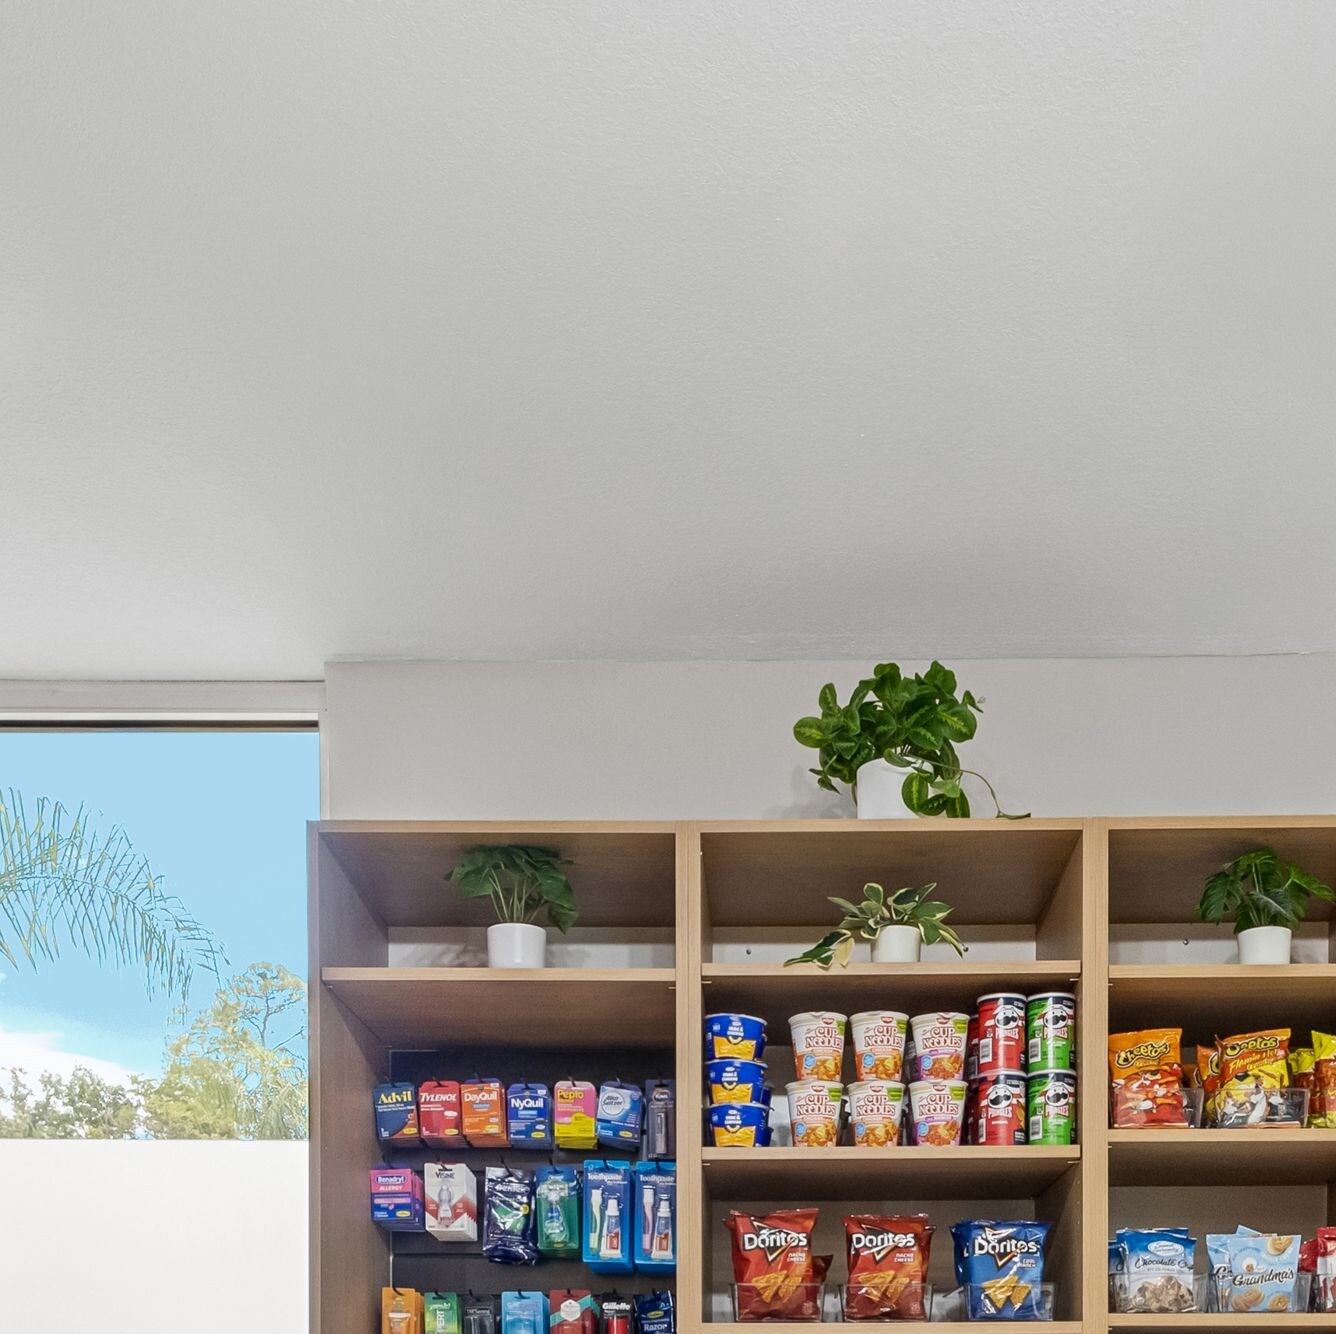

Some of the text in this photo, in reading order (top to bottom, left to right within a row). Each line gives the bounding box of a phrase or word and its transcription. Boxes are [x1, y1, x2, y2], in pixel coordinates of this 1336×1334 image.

[815, 1027, 839, 1037] CUP
[874, 1026, 898, 1036] CUP
[930, 1027, 955, 1037] CUP
[922, 1037, 962, 1049] NOODLES
[1226, 1037, 1278, 1056] Ceetos
[1117, 1043, 1168, 1064] Cheetos
[378, 1091, 412, 1104] Advil
[420, 1092, 457, 1102] TYLENOL
[464, 1092, 497, 1103] DayQuil
[557, 1089, 584, 1100] Pepto
[804, 1095, 830, 1105] CUP
[864, 1095, 889, 1105] CUP
[927, 1094, 952, 1105] CUP
[510, 1097, 544, 1110] NyQuil
[796, 1104, 836, 1116] NOODLES
[856, 1104, 896, 1116] NOODLES
[918, 1104, 959, 1115] NOODLES
[377, 1175, 404, 1183] Benadryl
[587, 1172, 623, 1183] Toothpaste
[639, 1174, 675, 1184] Toothpaste
[743, 1232, 807, 1250] Doritos
[852, 1232, 915, 1248] Doritos
[974, 1237, 1038, 1255] Doritos
[1135, 1257, 1176, 1269] Chocolate
[1232, 1268, 1294, 1286] Grandma's
[602, 1302, 630, 1310] Gillette
[643, 1324, 668, 1332] Razor
